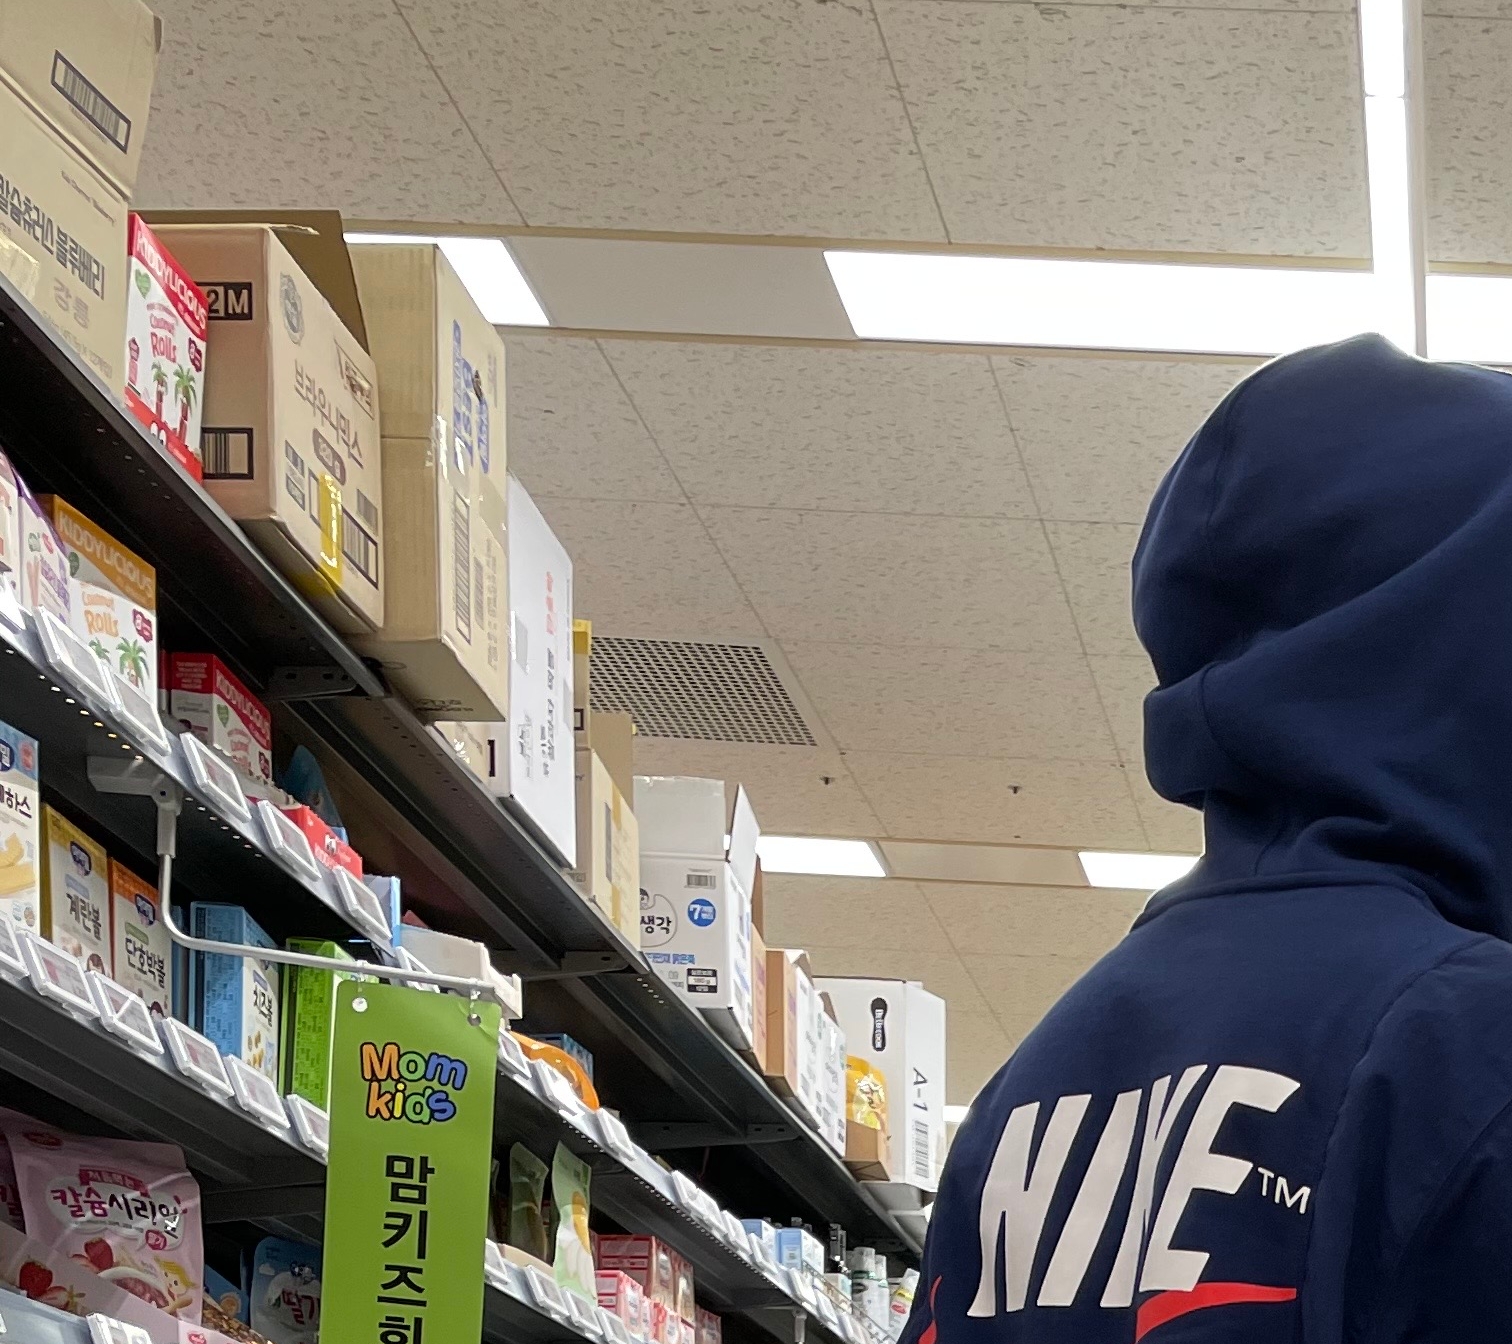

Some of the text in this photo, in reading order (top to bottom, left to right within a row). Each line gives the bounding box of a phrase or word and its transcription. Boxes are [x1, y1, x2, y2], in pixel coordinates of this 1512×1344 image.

[360, 1042, 468, 1091] Mom
[366, 1081, 456, 1124] kids
[1257, 1167, 1310, 1215] TM
